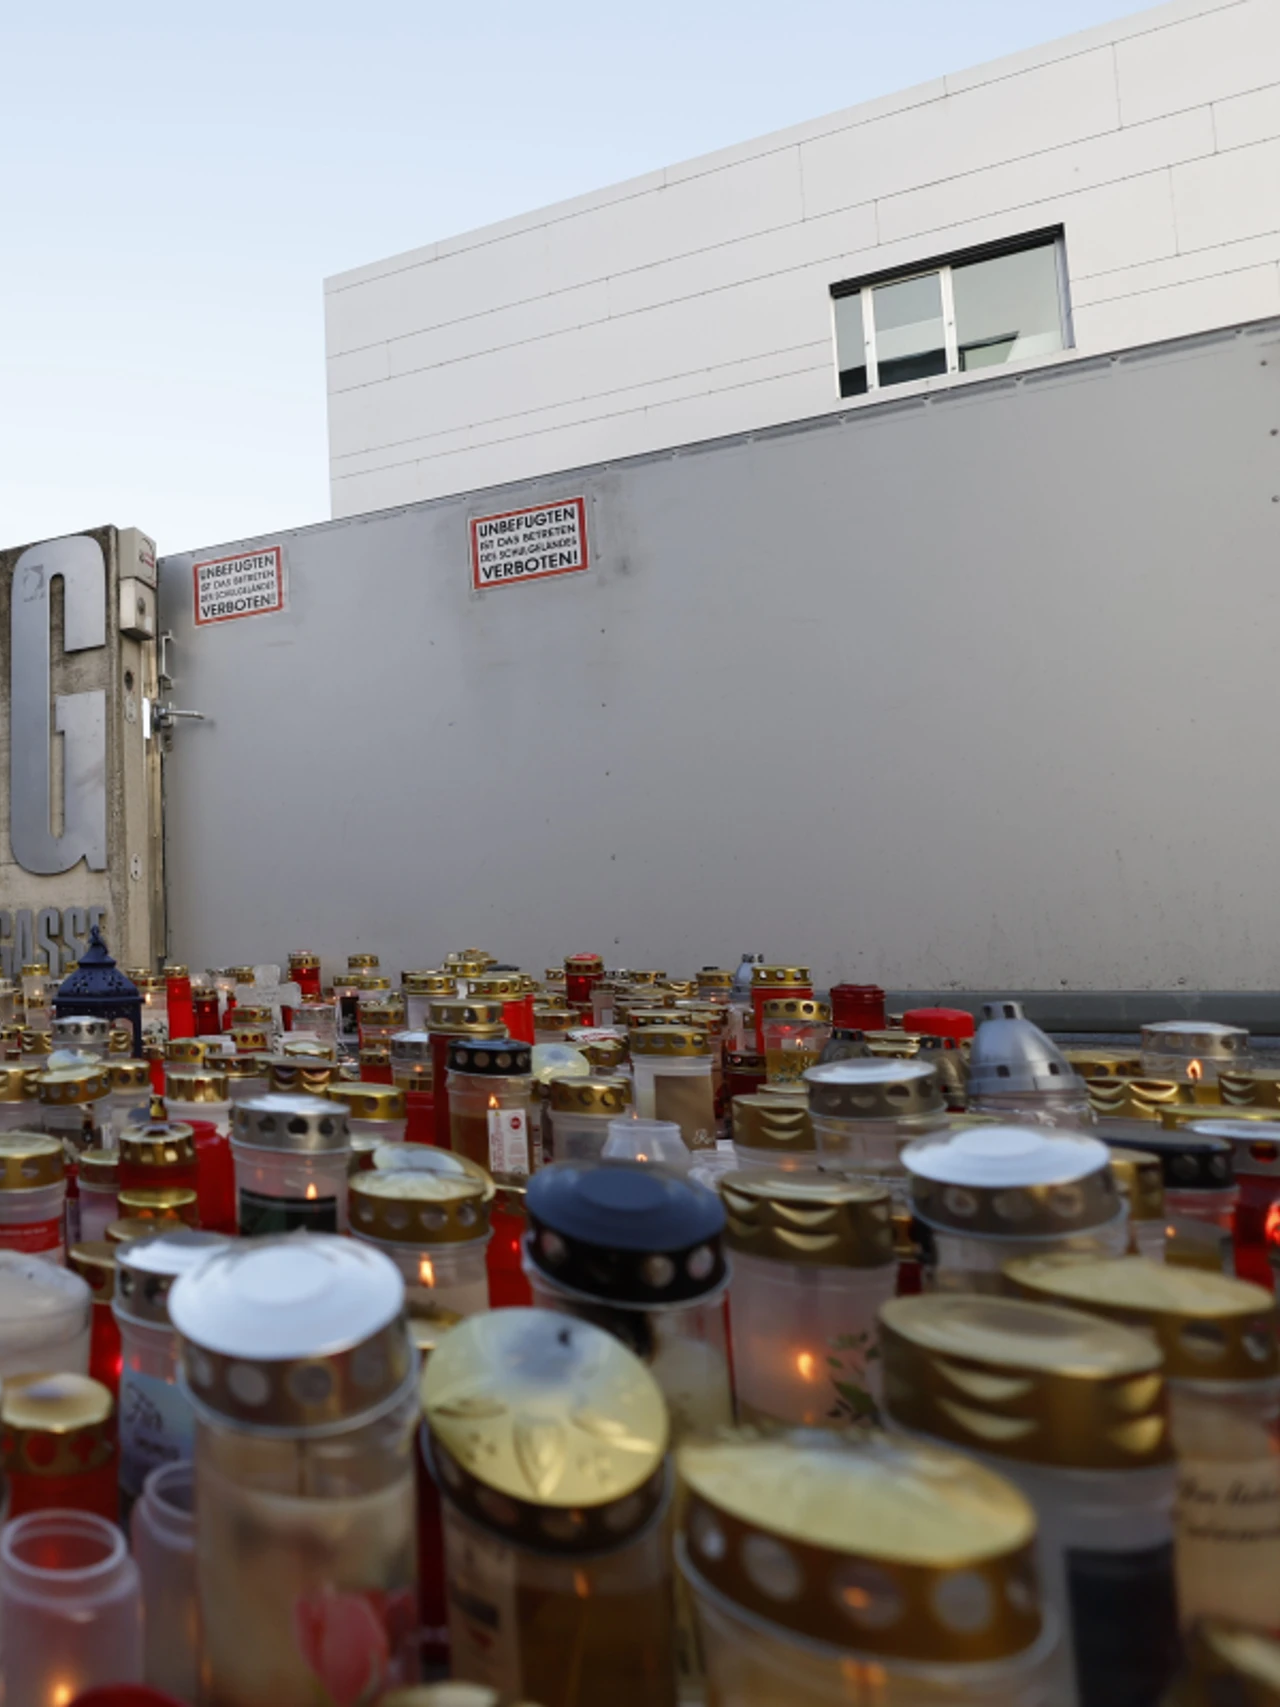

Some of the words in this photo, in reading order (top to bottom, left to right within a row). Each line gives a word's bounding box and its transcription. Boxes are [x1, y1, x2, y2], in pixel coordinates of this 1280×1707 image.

[480, 507, 575, 537] UNBEFUGTEN
[480, 540, 494, 551] IST
[497, 534, 519, 547] DAS
[523, 524, 575, 542] BETRETEN
[201, 555, 274, 579] UNBEFUGTEN
[482, 550, 578, 579] VERBOTEN!
[214, 578, 231, 589] DAS
[201, 593, 276, 617] VERBOTEN!
